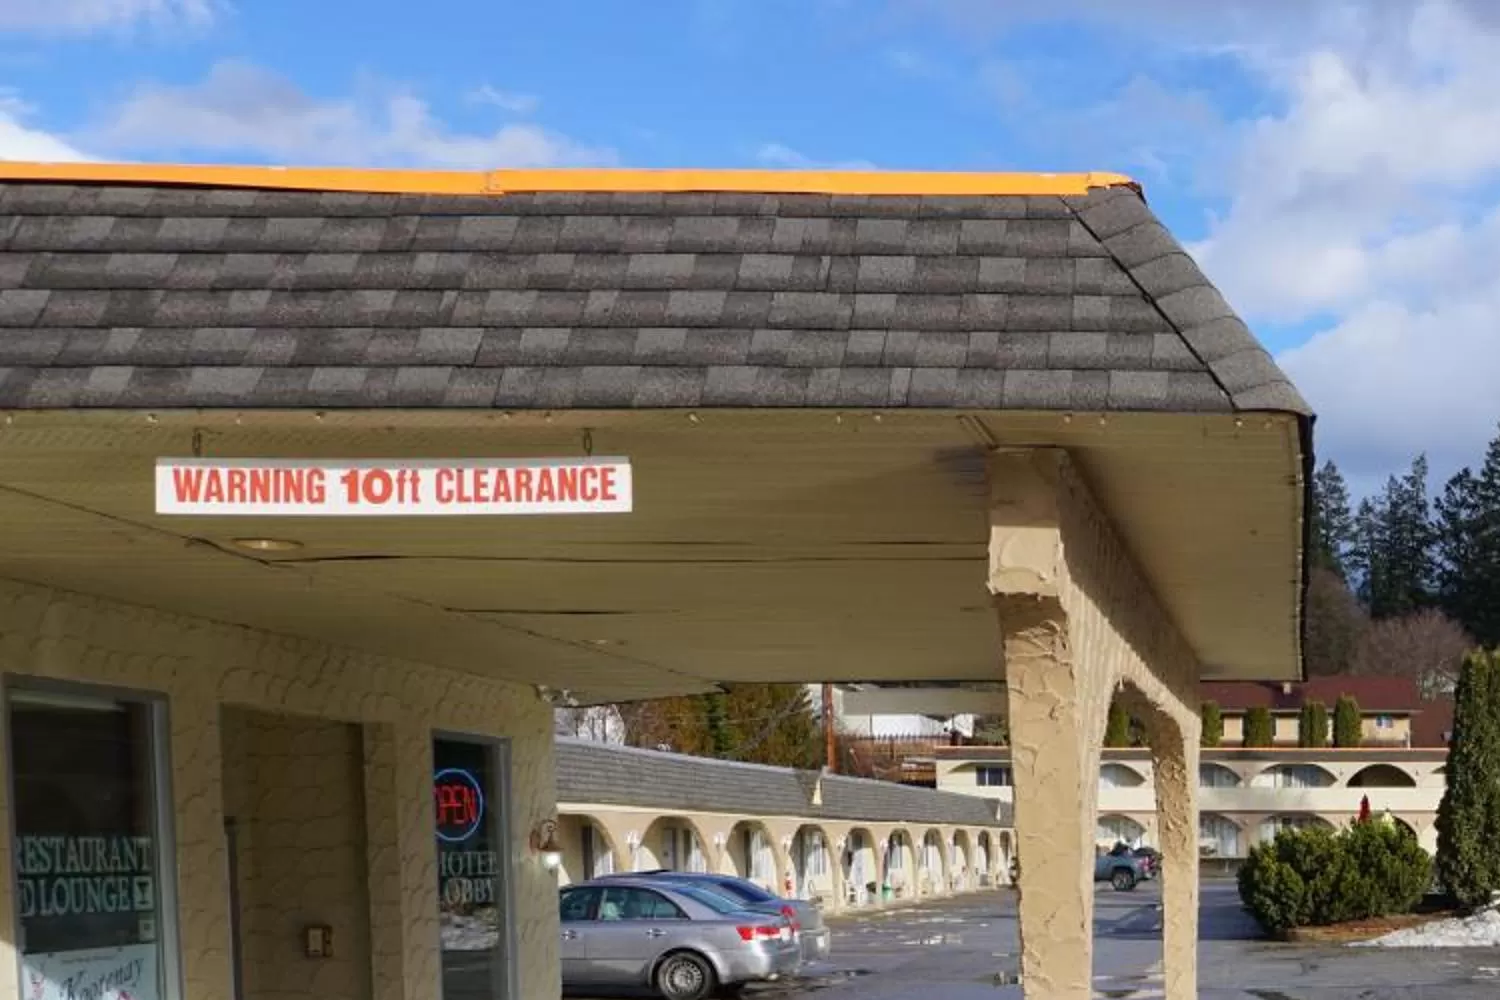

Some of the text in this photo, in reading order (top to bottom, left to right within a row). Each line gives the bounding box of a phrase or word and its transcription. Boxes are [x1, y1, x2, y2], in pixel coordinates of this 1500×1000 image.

[172, 465, 617, 505] WARNING 10ft CLEARANCE
[38, 876, 131, 916] LOUNGE
[438, 877, 496, 905] OBBY
